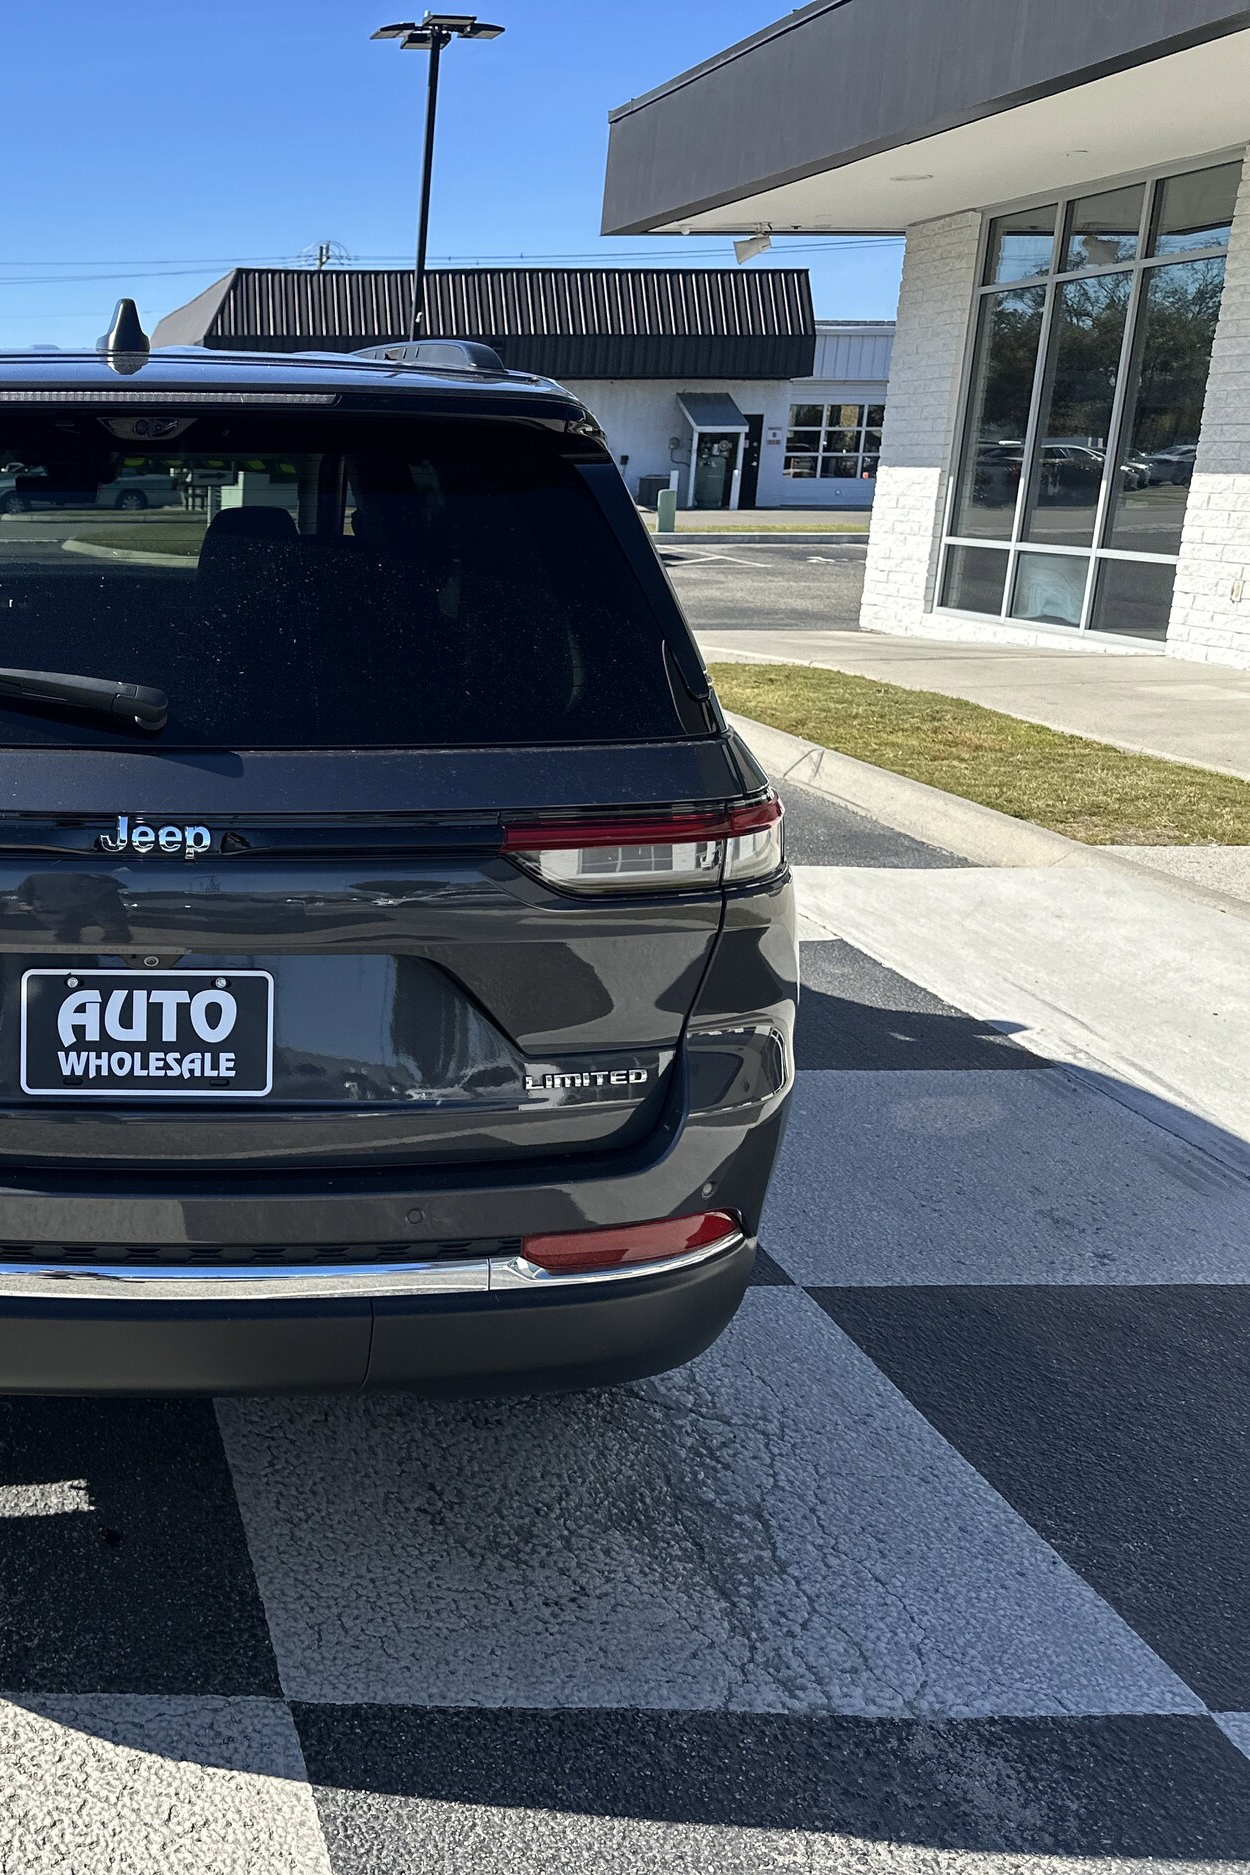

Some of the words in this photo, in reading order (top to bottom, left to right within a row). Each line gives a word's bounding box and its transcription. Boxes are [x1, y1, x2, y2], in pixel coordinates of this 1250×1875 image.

[99, 815, 211, 860] Jeep
[57, 989, 238, 1048] AUTO
[57, 1051, 237, 1079] WHOLESALE
[525, 1069, 648, 1090] LIMITED
